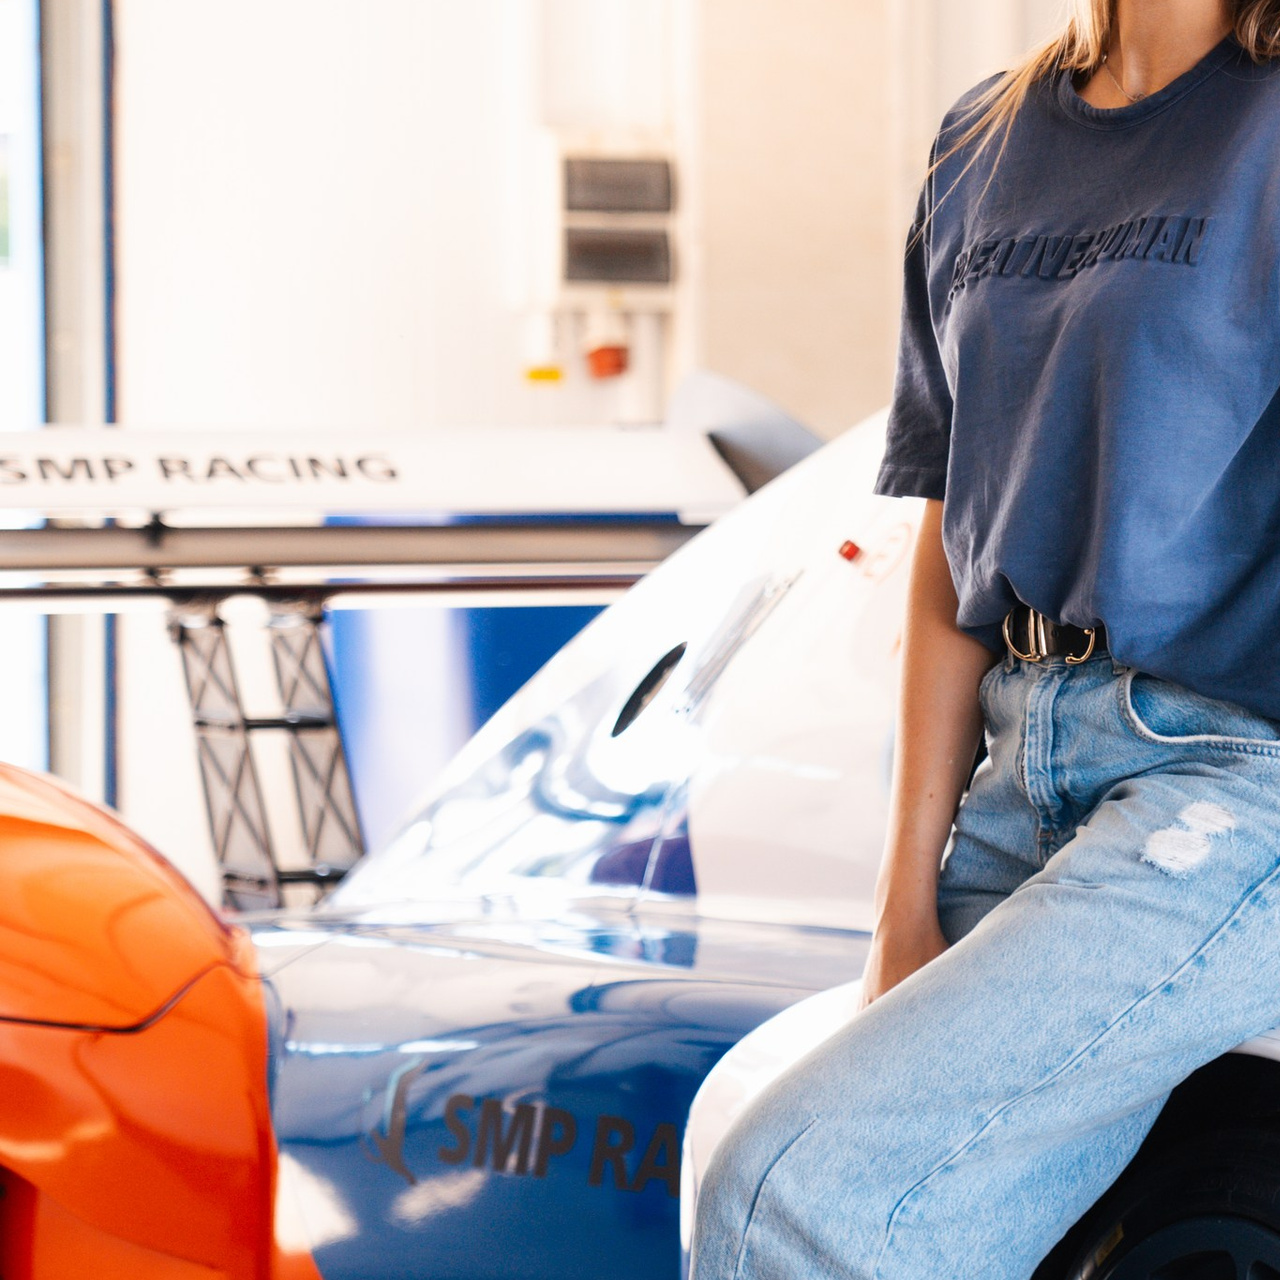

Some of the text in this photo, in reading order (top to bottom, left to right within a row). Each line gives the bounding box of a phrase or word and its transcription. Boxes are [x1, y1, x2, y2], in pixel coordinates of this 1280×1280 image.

[0, 455, 400, 484] SMP RACING
[437, 1093, 577, 1179] SMP
